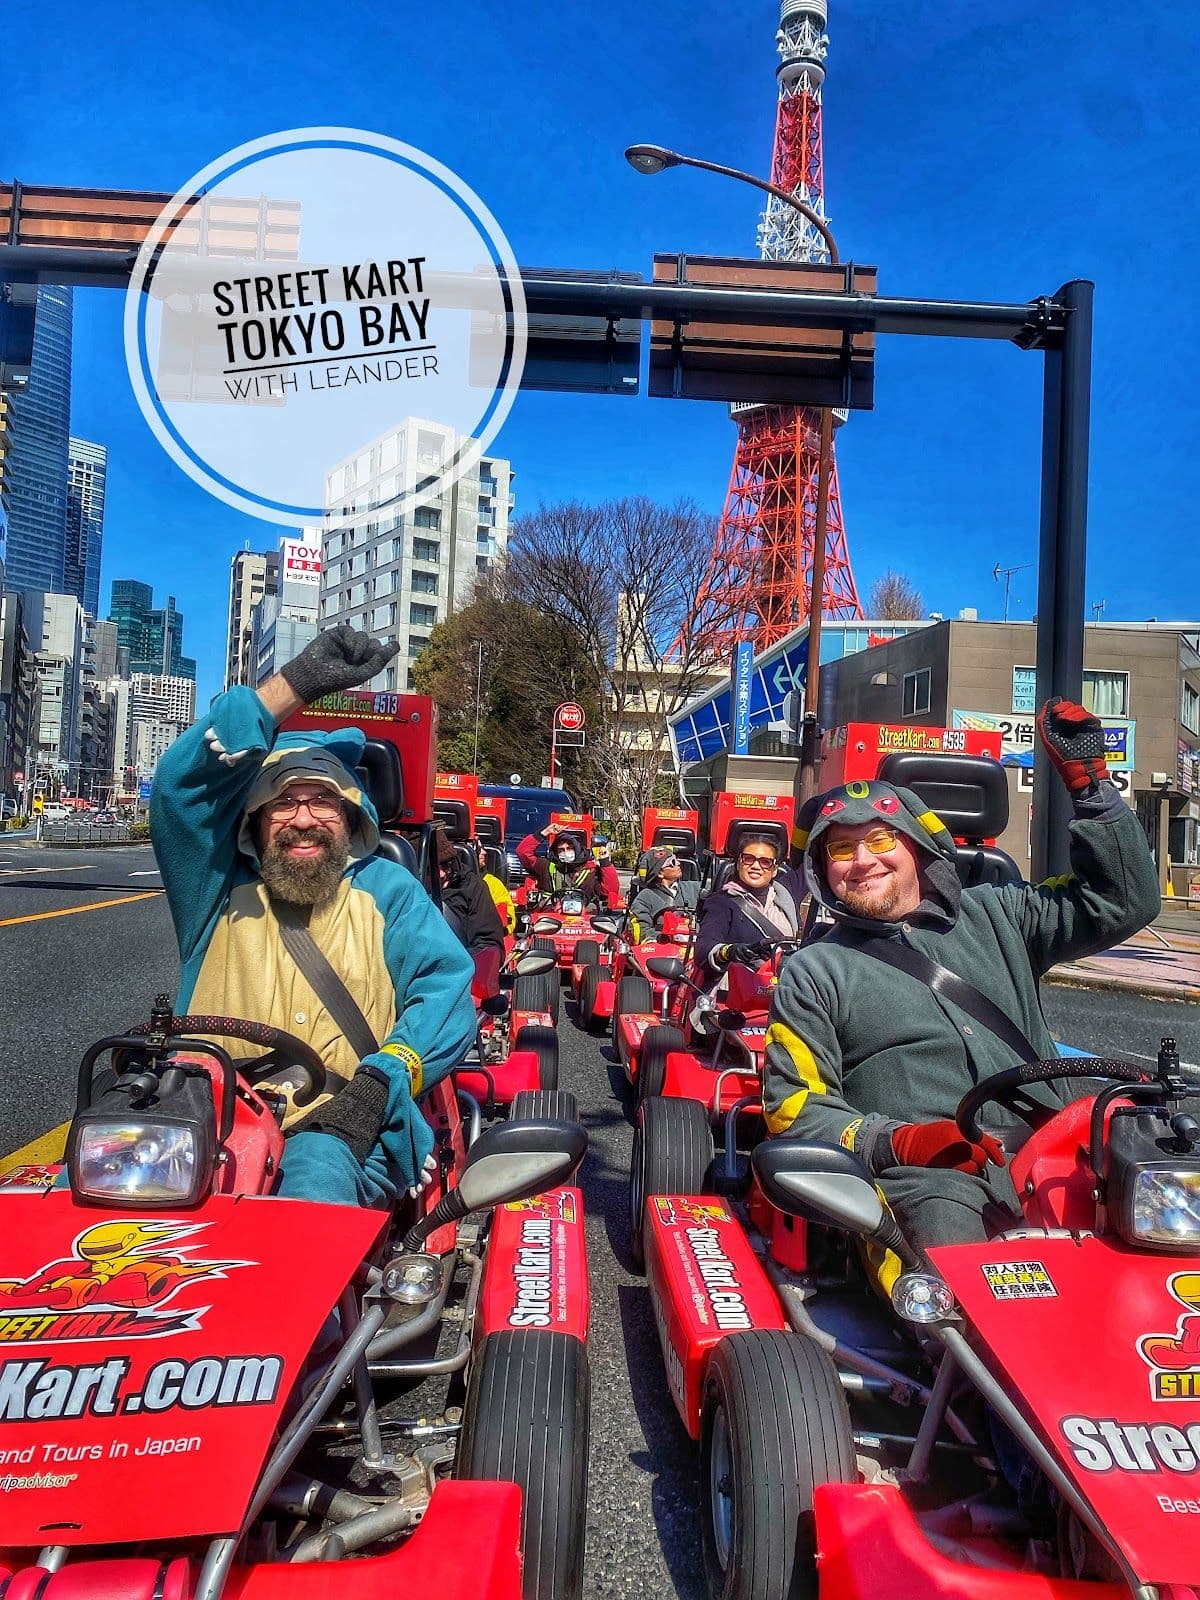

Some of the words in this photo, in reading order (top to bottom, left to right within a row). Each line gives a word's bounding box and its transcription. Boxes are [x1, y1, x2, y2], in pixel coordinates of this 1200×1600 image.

[373, 694, 398, 714] #513
[942, 731, 966, 750] #539
[984, 1262, 1043, 1275] 対人対物
[42, 1443, 104, 1463] Tours
[108, 1440, 128, 1459] in
[134, 1435, 202, 1457] Japan
[1157, 1495, 1200, 1514] Bes
